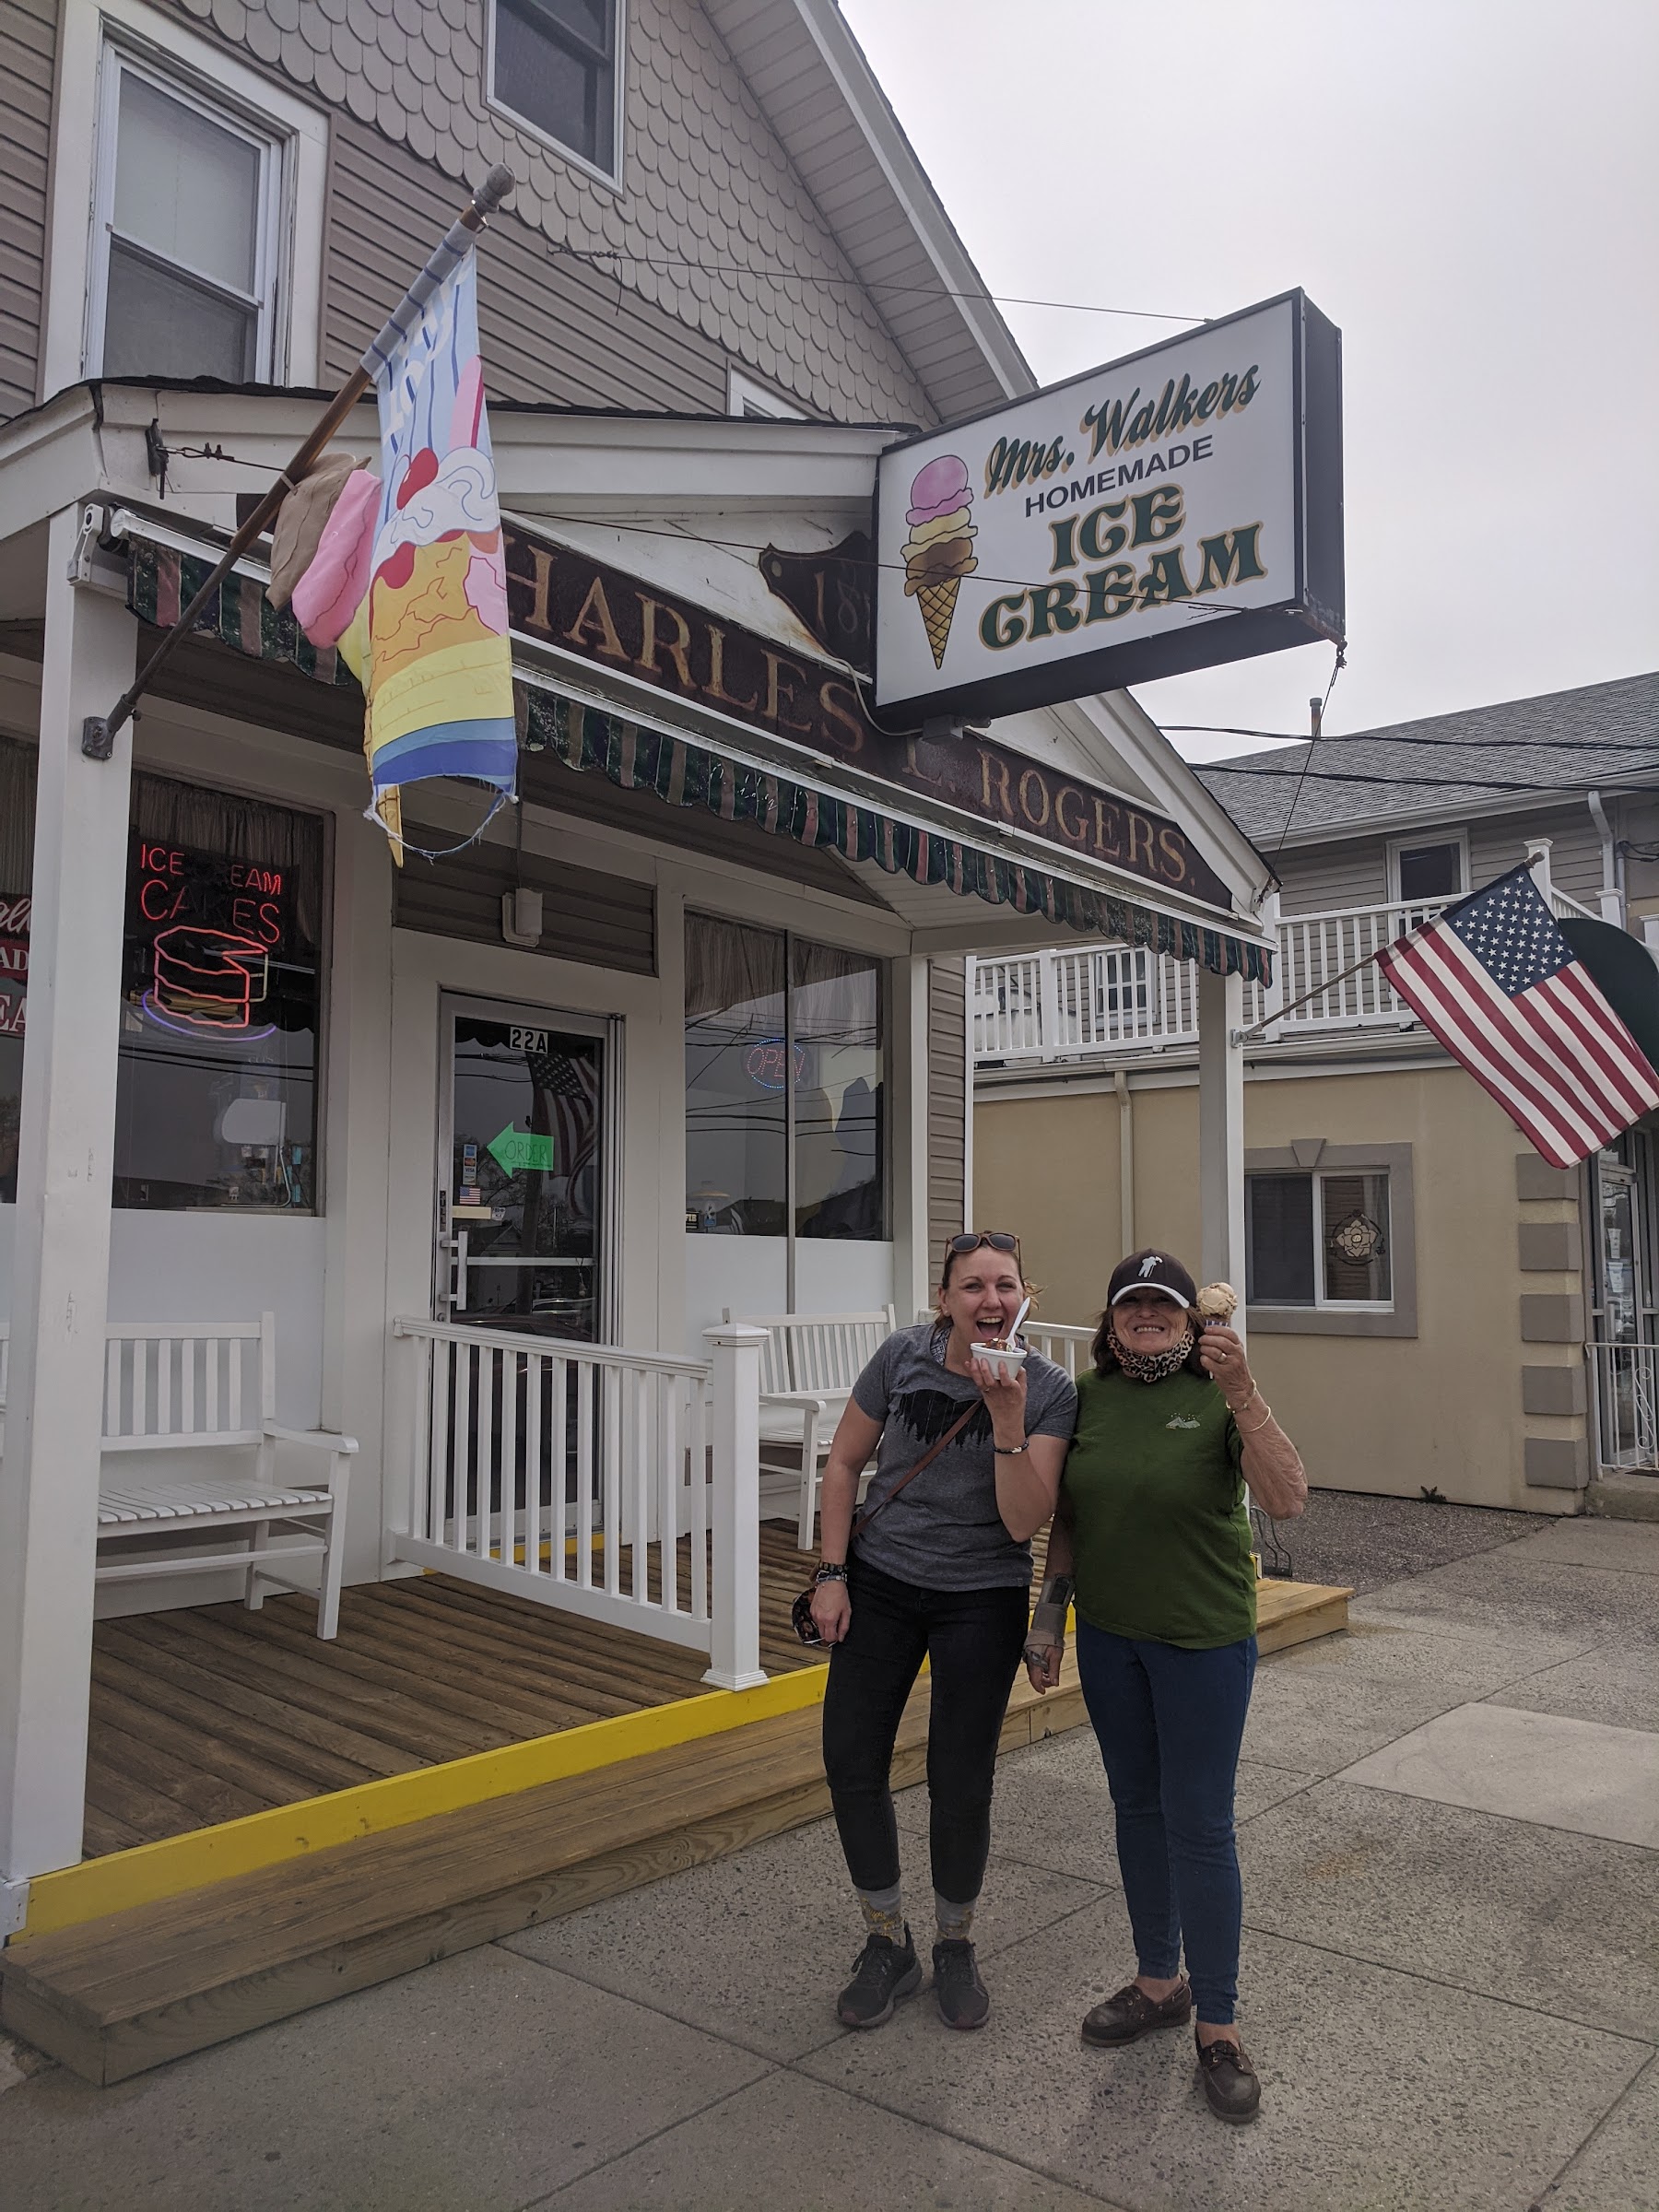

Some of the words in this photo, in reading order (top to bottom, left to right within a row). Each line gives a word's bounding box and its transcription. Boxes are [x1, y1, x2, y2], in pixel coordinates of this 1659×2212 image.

[983, 436, 1077, 499] Mrs.
[1081, 364, 1262, 463] Walkers
[1025, 434, 1214, 518] HOMEMADE
[1049, 484, 1186, 575] ICE
[813, 560, 871, 640] 18
[979, 521, 1268, 652] CREAM
[503, 535, 865, 754] HARLES
[977, 748, 1196, 888] ROGERS.
[140, 842, 185, 876] ICE
[512, 1029, 547, 1053] 22A
[747, 1047, 806, 1078] OPEN
[504, 1139, 547, 1166] ORDER
